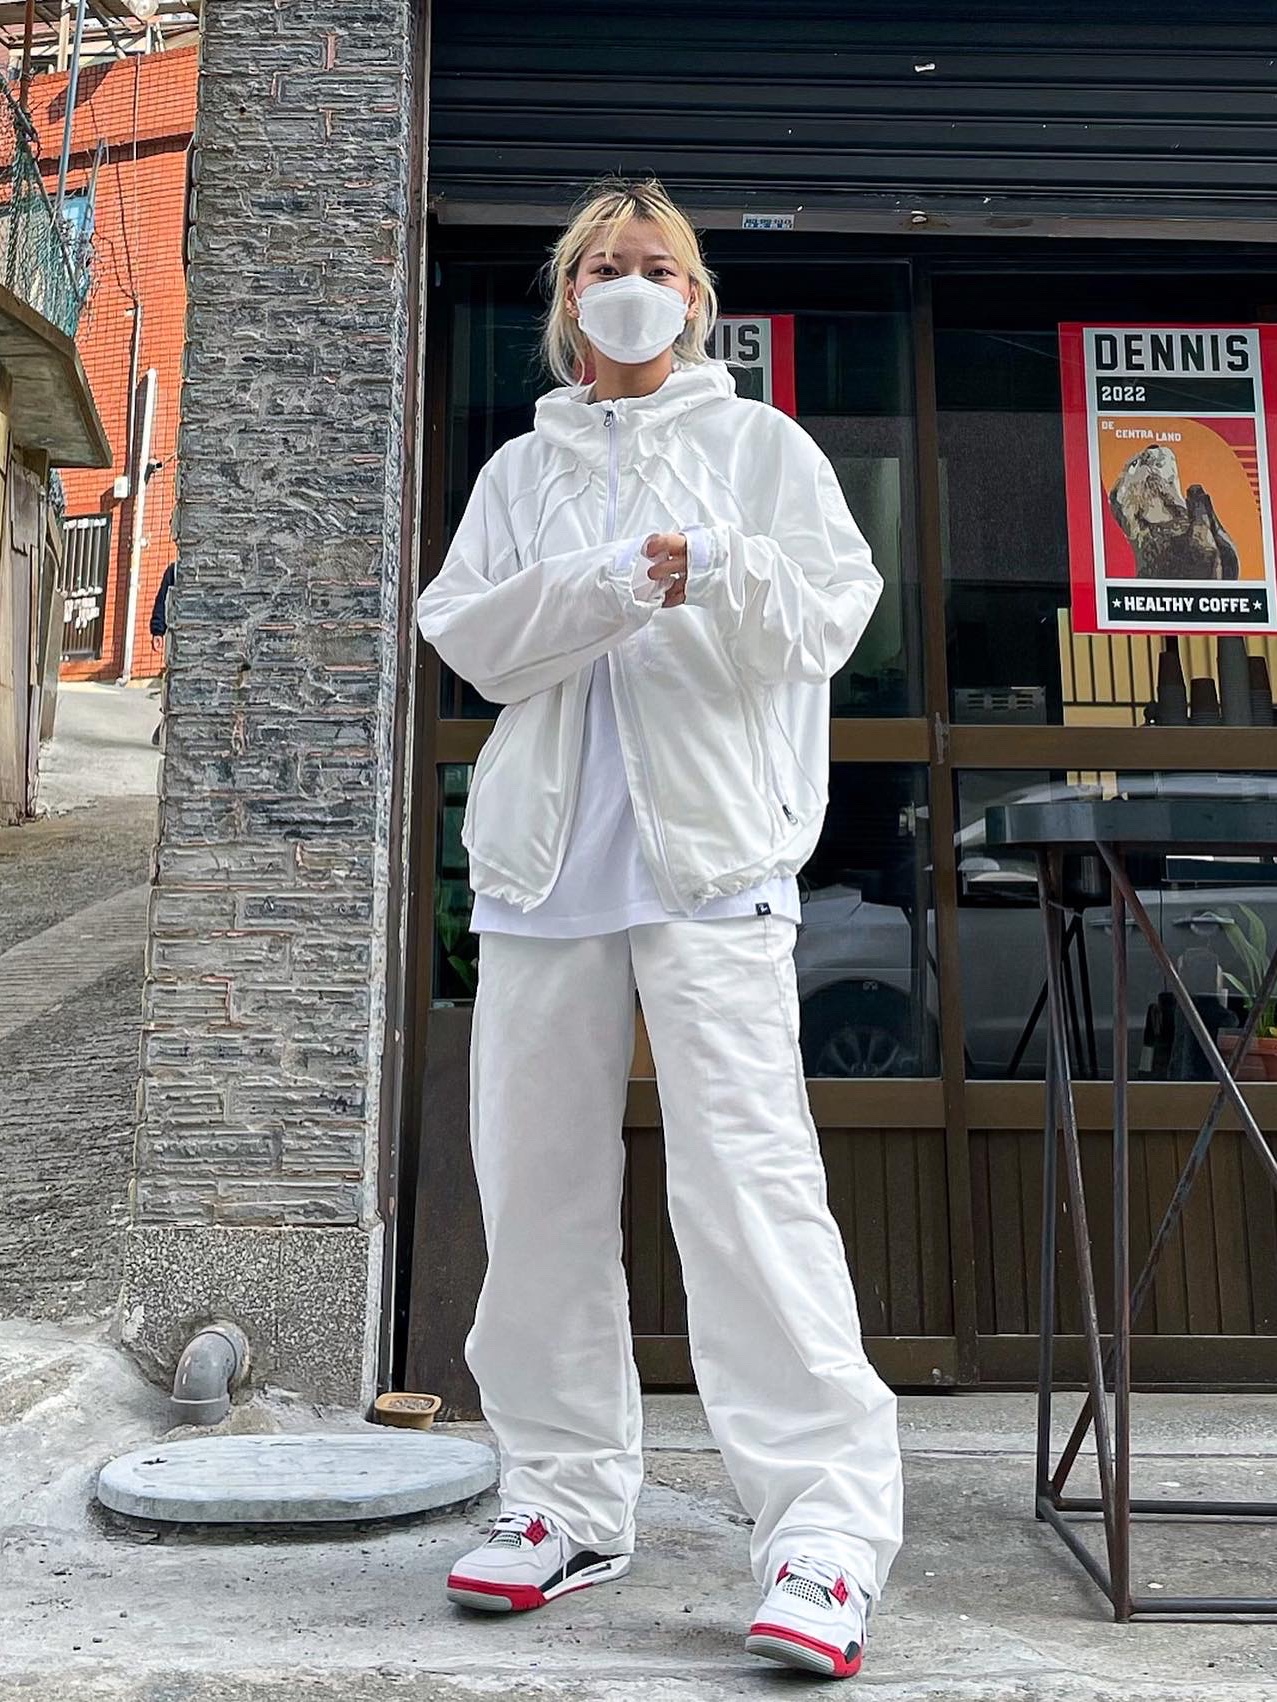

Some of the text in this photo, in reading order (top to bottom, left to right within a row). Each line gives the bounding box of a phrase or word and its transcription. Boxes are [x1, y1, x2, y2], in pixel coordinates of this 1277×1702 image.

[1094, 333, 1250, 373] DENNIS
[1101, 385, 1147, 402] 2022
[1101, 420, 1115, 430] DE
[1115, 429, 1154, 439] CENTRA
[1155, 432, 1182, 442] LAND
[1123, 595, 1251, 614] HEALTHY COFFE
